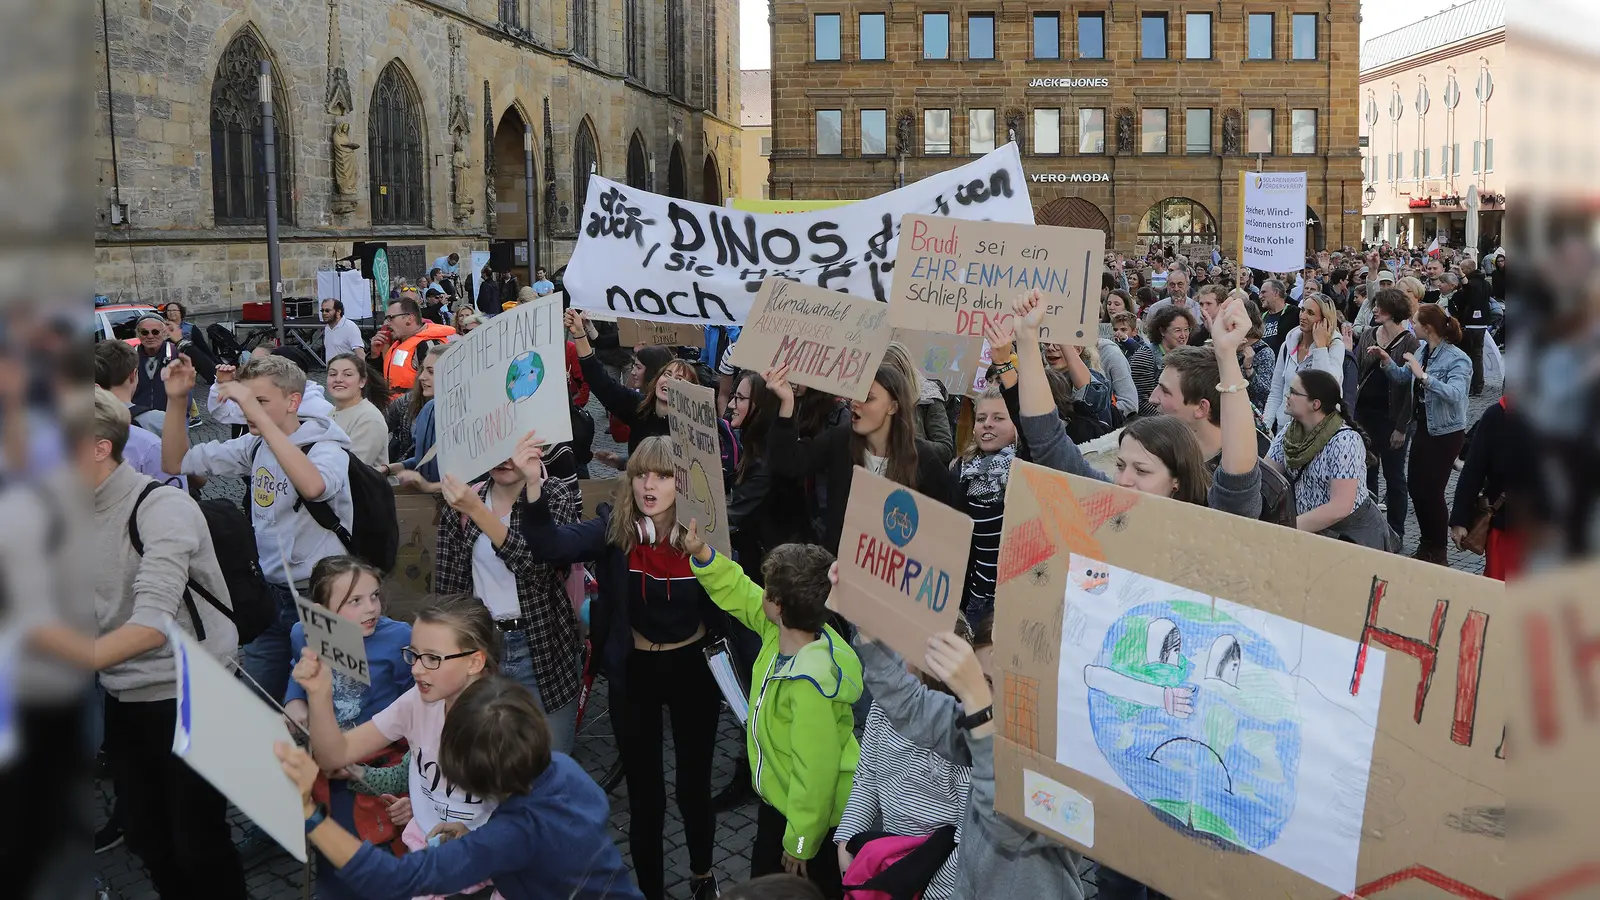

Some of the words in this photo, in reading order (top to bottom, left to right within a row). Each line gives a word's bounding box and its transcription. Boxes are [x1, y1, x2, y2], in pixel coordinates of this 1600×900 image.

[1028, 78, 1059, 87] JACK
[1071, 78, 1109, 87] JONES
[1031, 173, 1067, 182] VERO
[1070, 173, 1110, 182] MODA
[1252, 218, 1304, 230] Sonnenstrom
[1266, 207, 1294, 217] Wind-
[668, 202, 849, 268] DINOS
[911, 220, 962, 259] Brudi,
[974, 240, 1006, 256] sei
[1021, 246, 1049, 261] ein
[1266, 236, 1295, 245] Kohle
[1253, 247, 1274, 257] Atom!
[605, 281, 737, 323] noch
[763, 280, 852, 322] Klimawandel
[972, 289, 1003, 311] dich
[466, 325, 494, 377] THE
[495, 300, 562, 363] PLANET
[854, 532, 951, 614] FAHRRAD
[320, 640, 368, 679] ERDE
